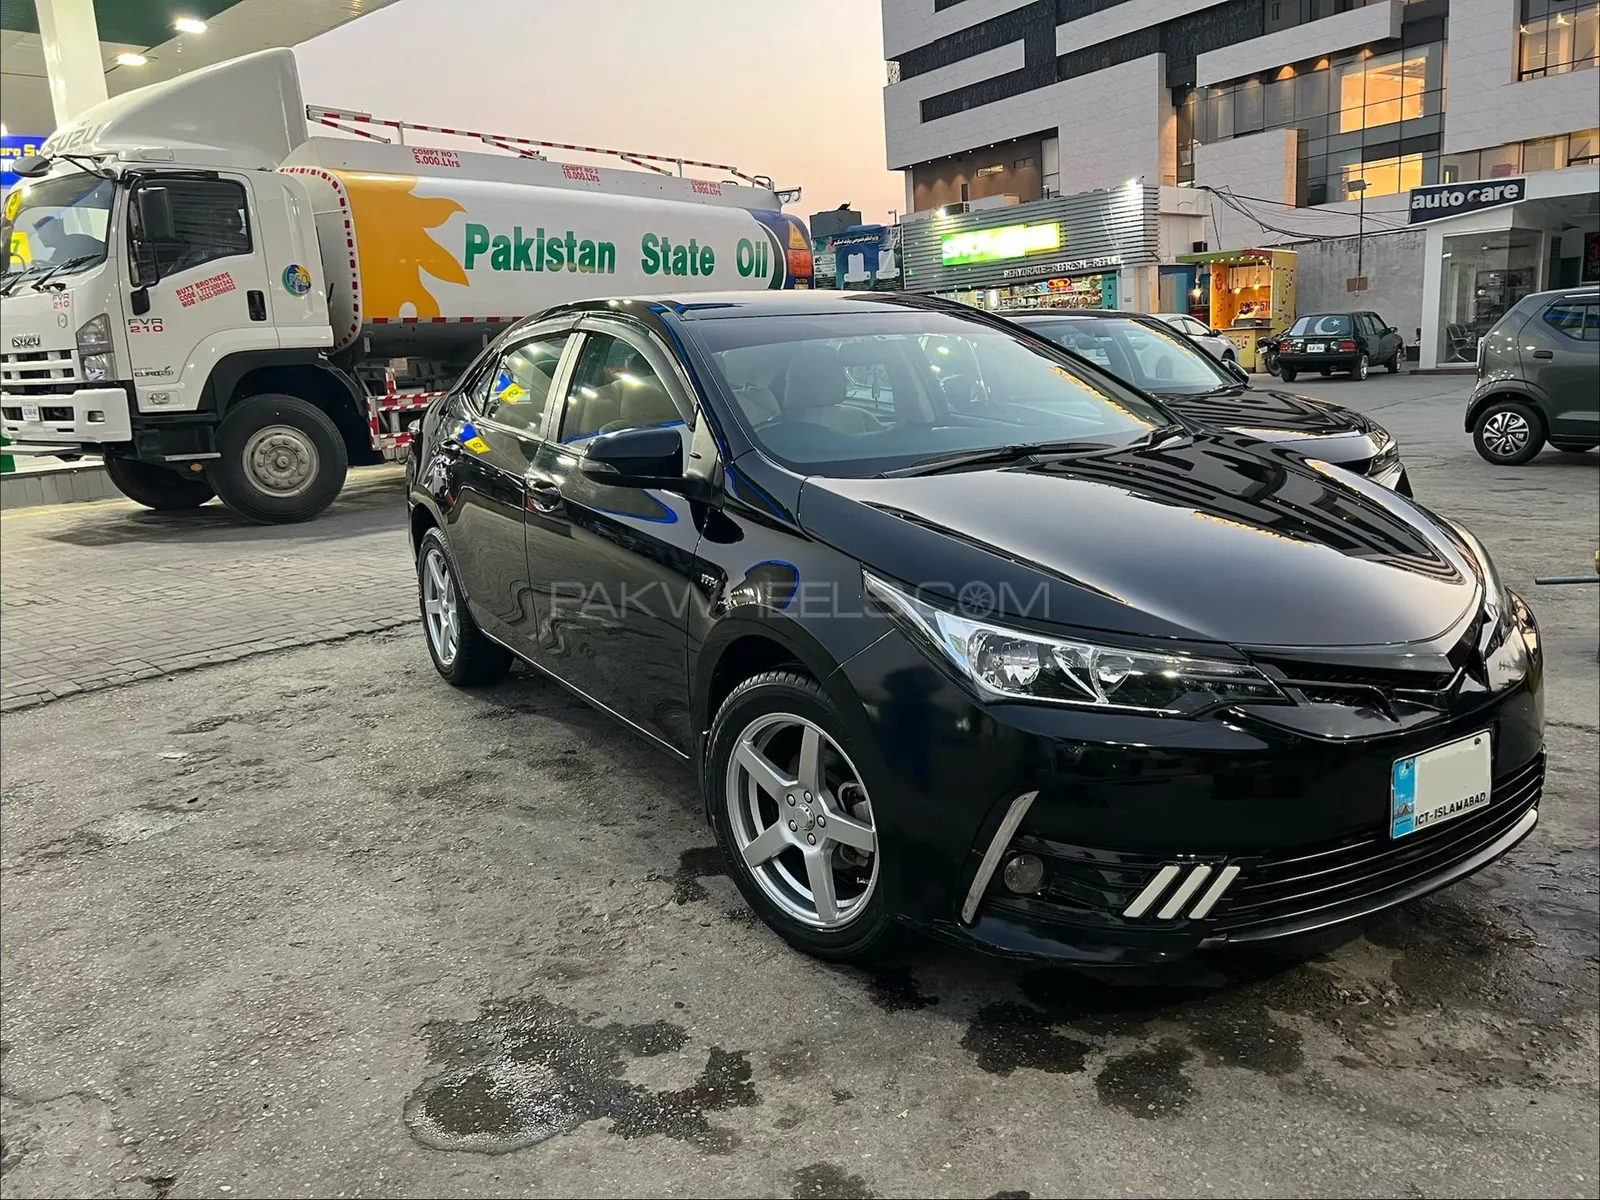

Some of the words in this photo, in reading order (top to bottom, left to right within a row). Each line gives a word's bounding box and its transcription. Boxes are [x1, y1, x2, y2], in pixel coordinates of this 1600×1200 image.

[411, 148, 439, 156] COMPT
[441, 150, 453, 158] NO
[1411, 190, 1465, 209] auto
[1467, 184, 1519, 204] care
[464, 223, 616, 274] Pakistan
[641, 232, 715, 276] State
[736, 237, 768, 278] Oil
[176, 285, 194, 296] BUTT
[195, 272, 230, 289] BROTHERS
[289, 273, 308, 287] PSO
[52, 293, 70, 301] FVR
[179, 291, 196, 301] CODE
[53, 300, 70, 309] 210
[182, 299, 196, 308] MOB
[130, 325, 164, 333] 210
[1415, 792, 1486, 826] ICT-ISLAMABAD
